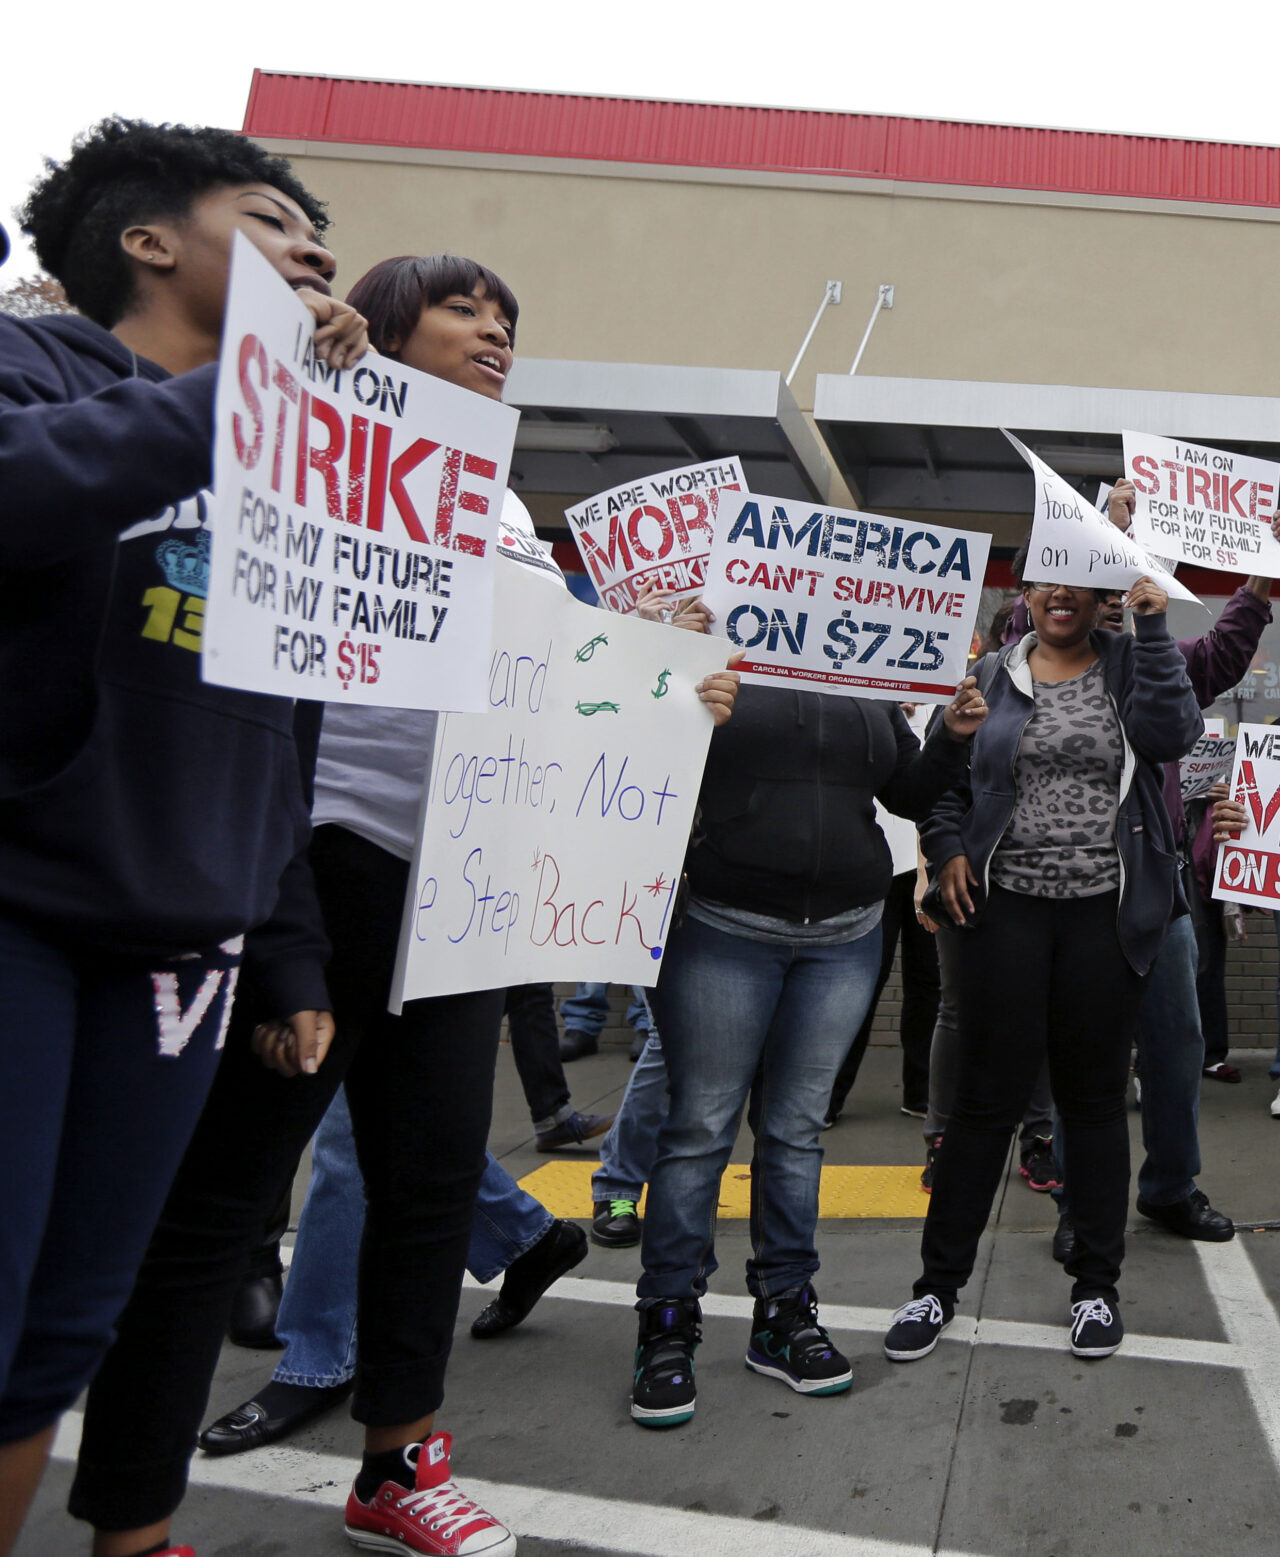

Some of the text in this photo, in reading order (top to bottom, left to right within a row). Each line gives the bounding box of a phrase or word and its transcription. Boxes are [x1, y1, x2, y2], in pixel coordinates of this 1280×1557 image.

[293, 322, 408, 418] I AM ON
[232, 333, 498, 558] STRIKE
[1175, 445, 1233, 473] I AM ON
[571, 463, 739, 530] WE ARE WORTH
[1042, 482, 1085, 523] food
[1132, 455, 1274, 524] STRIKE
[1149, 499, 1261, 539] FOR MY FUTURE
[239, 486, 279, 552] FOR
[285, 514, 324, 568] MY
[333, 532, 454, 599] FUTURE
[727, 501, 971, 581] AMERICA
[1089, 543, 1139, 572] public
[1150, 517, 1262, 554] FOR MY FAMILY
[1182, 541, 1239, 567] FOR $15
[233, 548, 449, 644] FOR MY FAMILY
[604, 556, 711, 614] ON STRIK
[726, 558, 966, 618] CAN'T SURVIVE
[272, 624, 382, 691] FOR $15
[726, 604, 950, 672] ON $7.25
[488, 640, 552, 713] ard
[752, 664, 911, 690] CAROLINA WORKERS ORGANIZING COMMITTEE
[576, 751, 678, 827] Not
[447, 847, 520, 956] Step
[1222, 851, 1268, 892] ON
